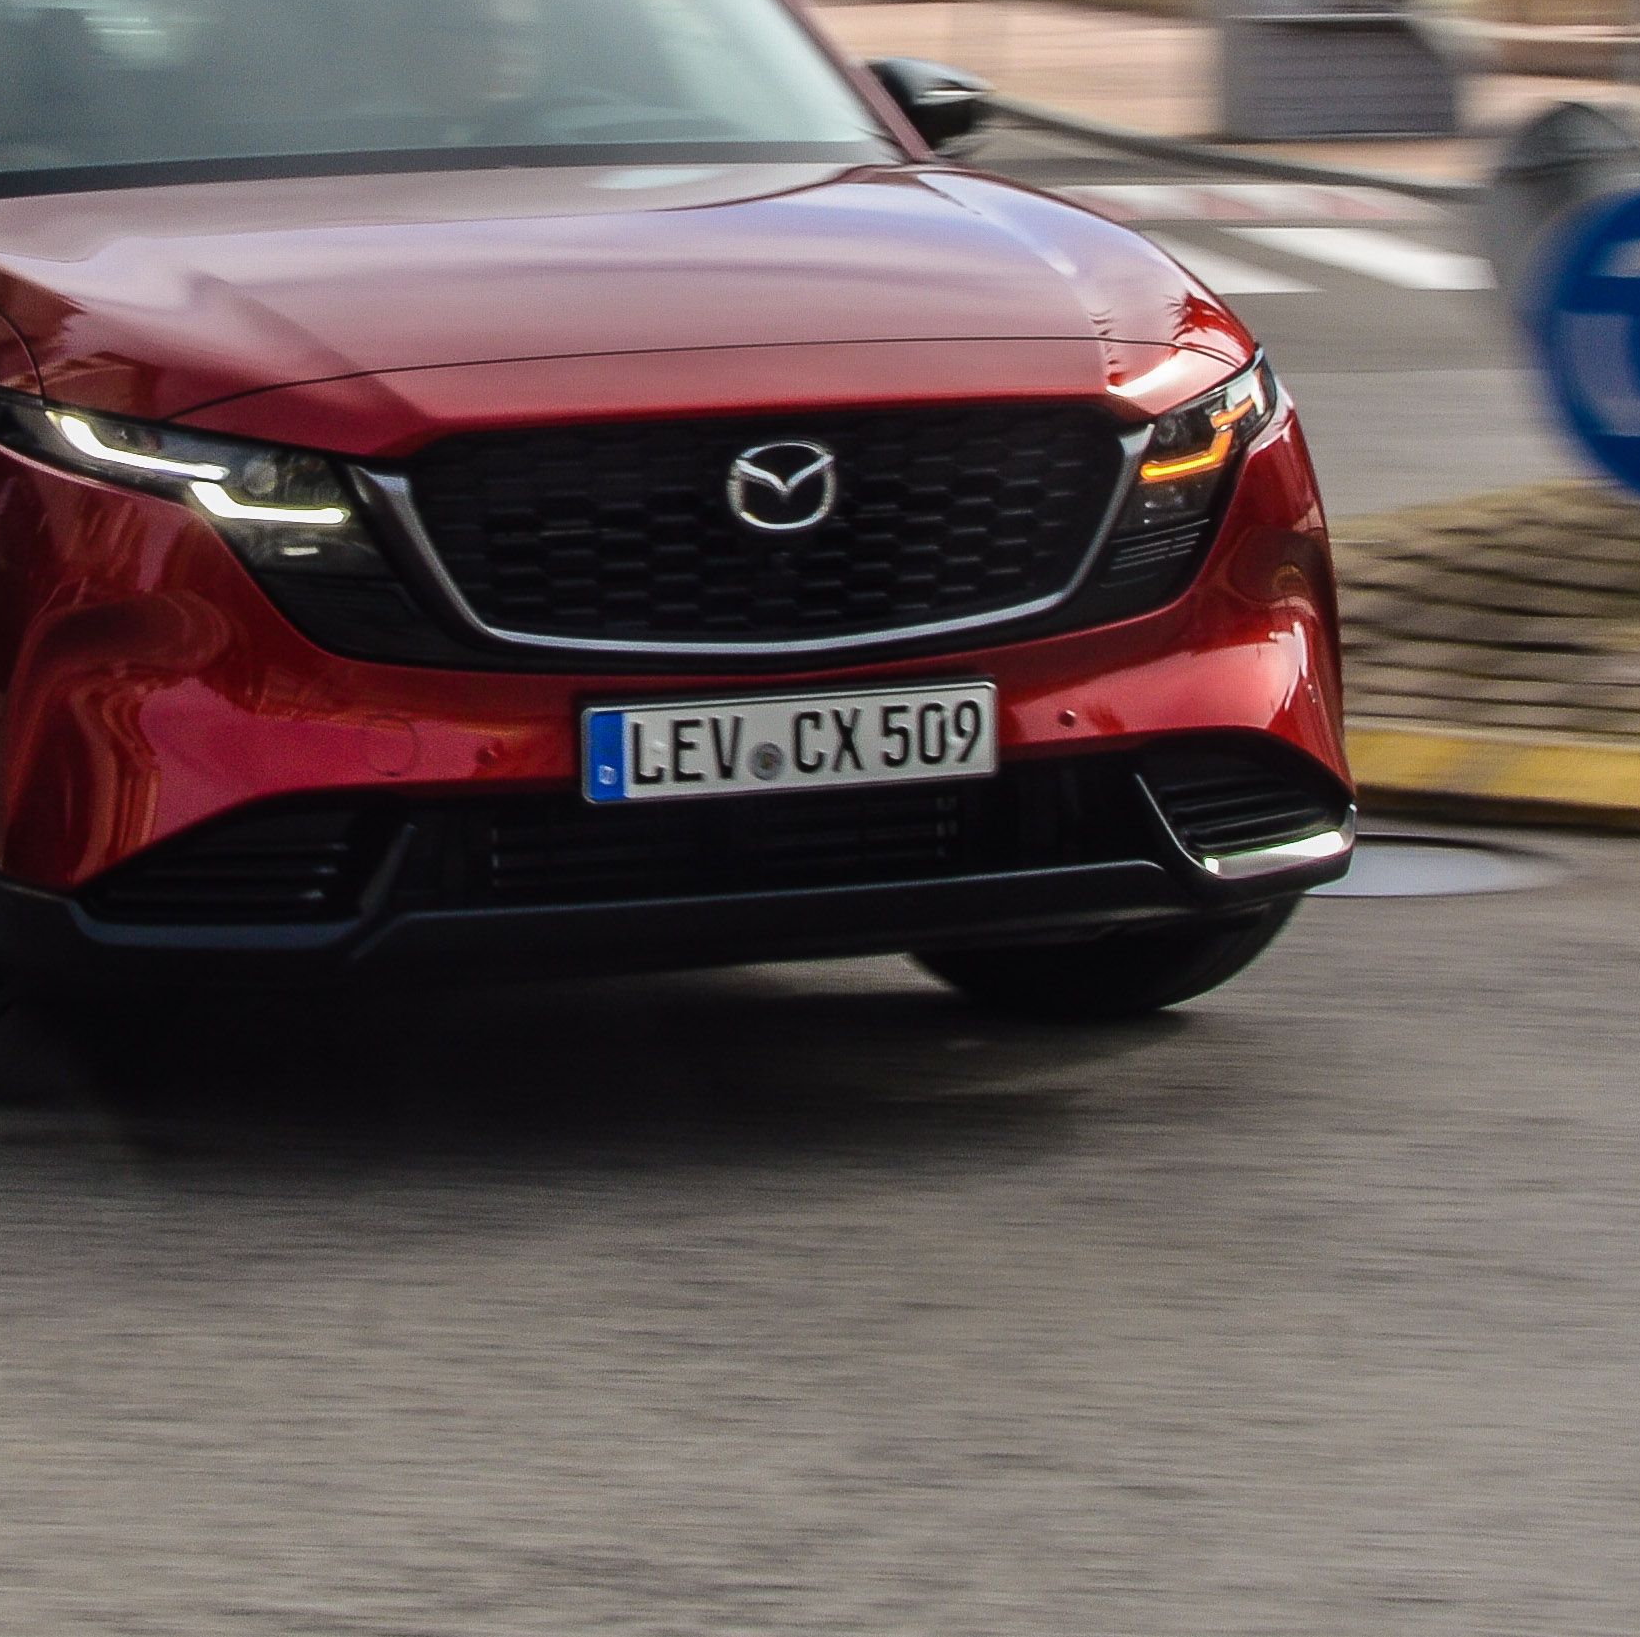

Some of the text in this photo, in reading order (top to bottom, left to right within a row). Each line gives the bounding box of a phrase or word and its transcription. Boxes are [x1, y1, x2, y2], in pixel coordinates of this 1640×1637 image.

[632, 700, 982, 785] LEV CX 509
